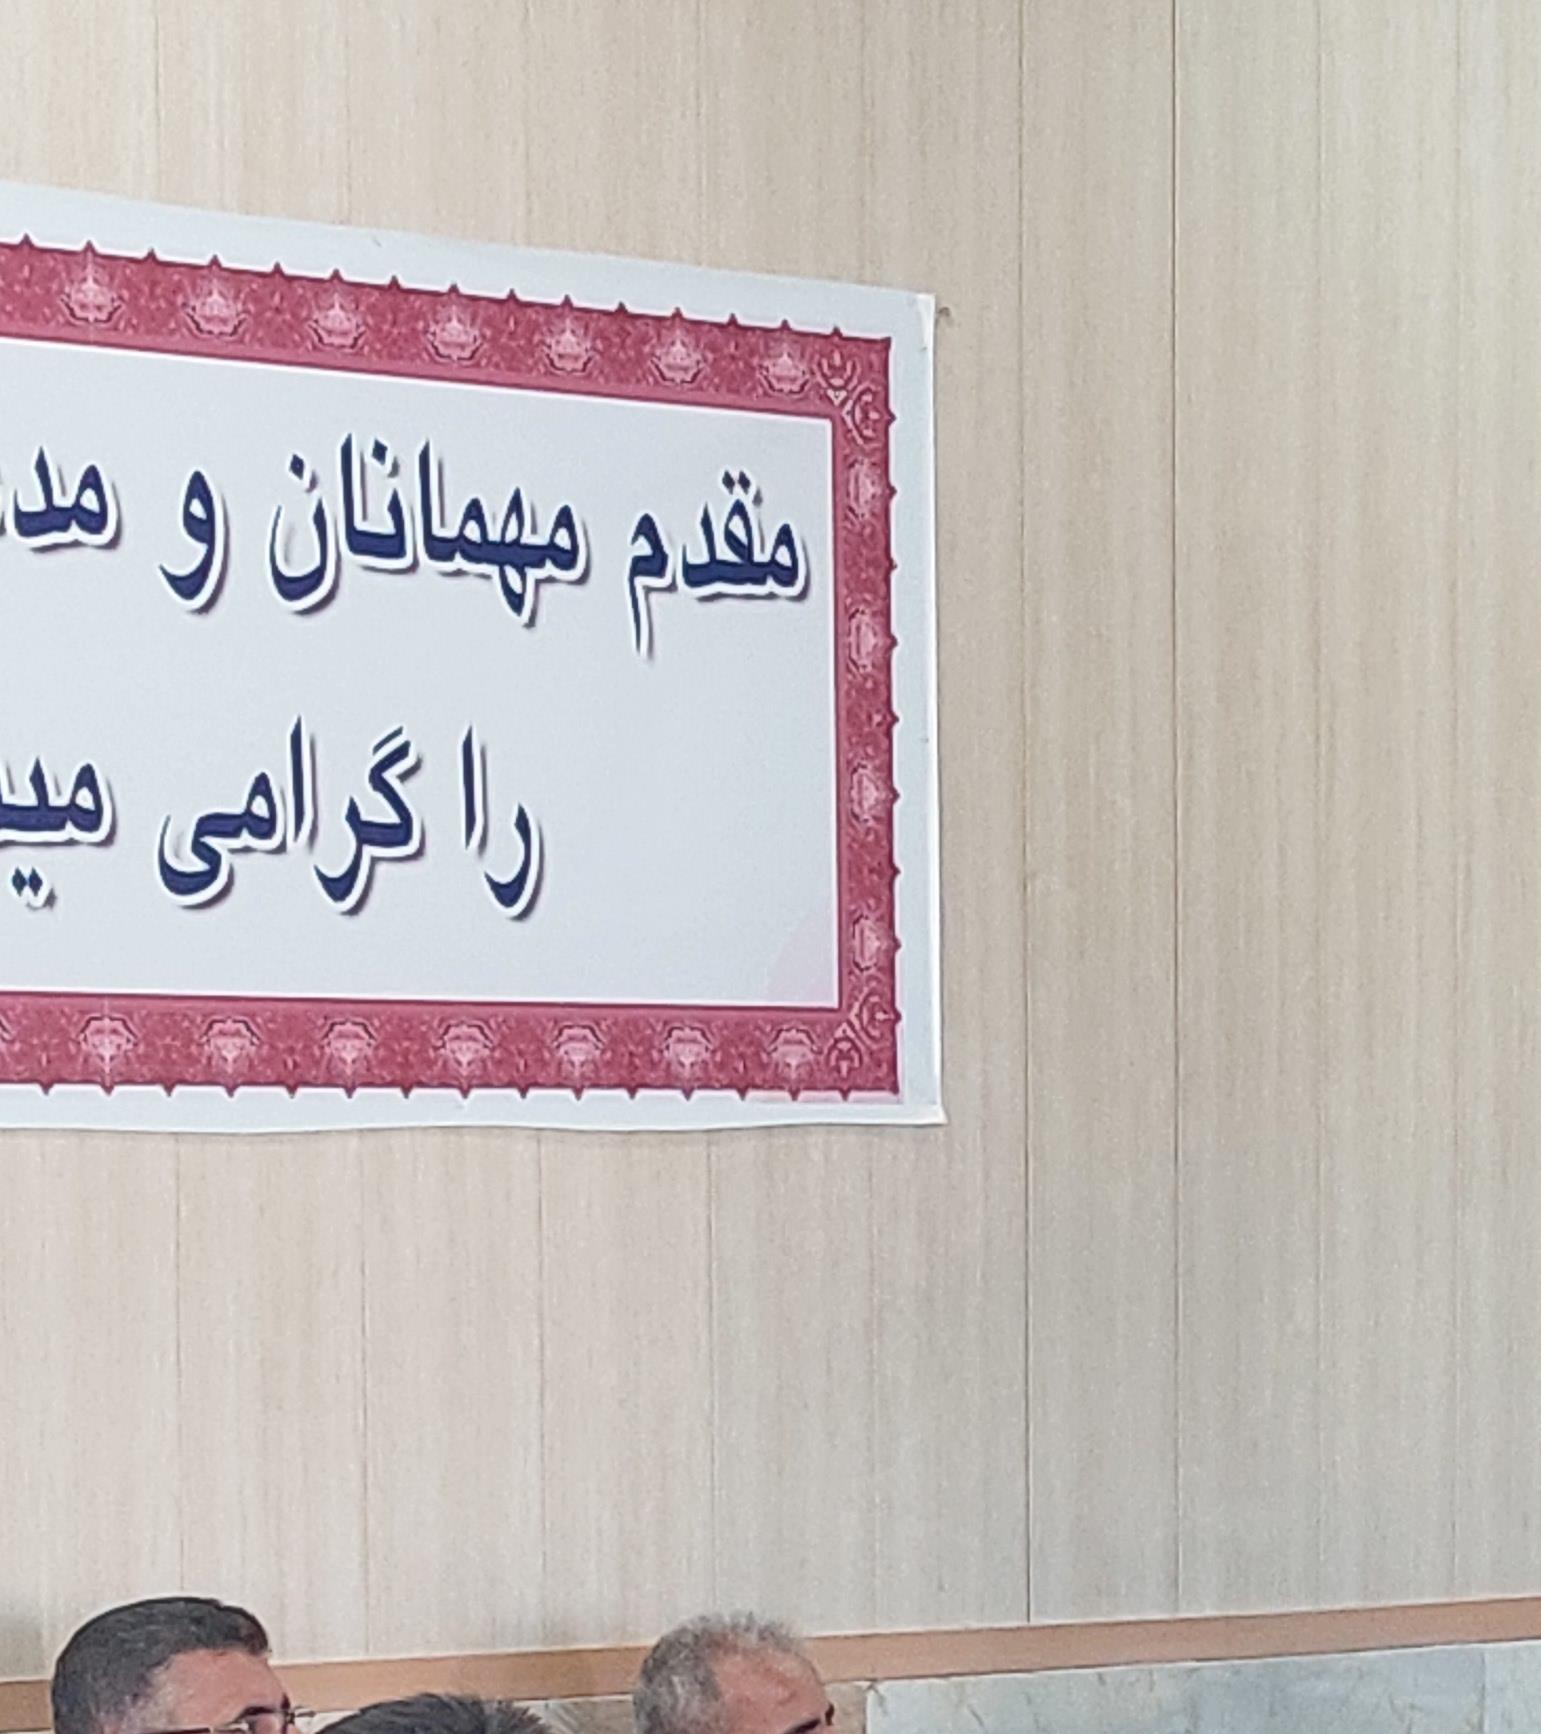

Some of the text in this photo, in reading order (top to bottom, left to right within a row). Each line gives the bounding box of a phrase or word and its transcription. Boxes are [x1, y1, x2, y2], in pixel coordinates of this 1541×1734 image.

[0, 435, 803, 648] مقدم مهمانان و مد
[0, 719, 545, 921] را گرامی می
